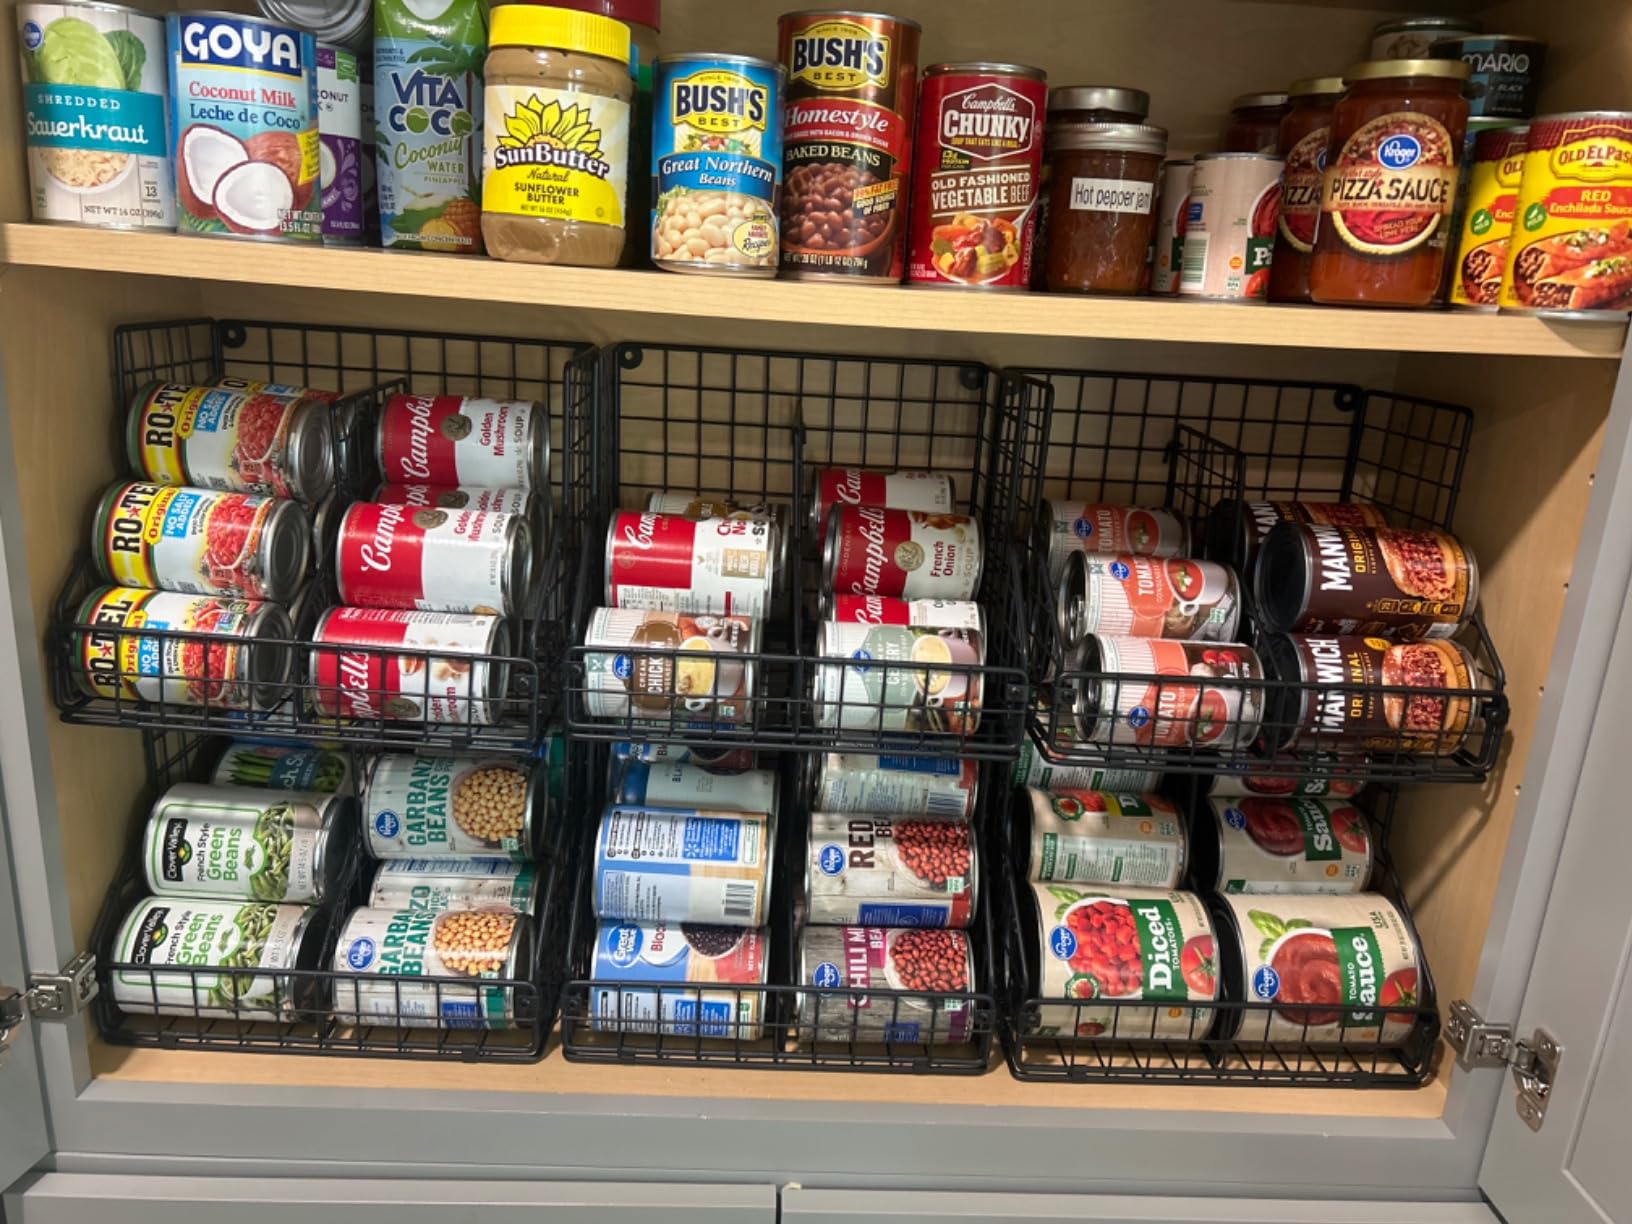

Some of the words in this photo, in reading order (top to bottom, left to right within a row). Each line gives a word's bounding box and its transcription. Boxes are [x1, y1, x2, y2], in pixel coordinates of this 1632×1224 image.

[184, 22, 297, 69] GOYA
[793, 38, 885, 76] BUSH'S
[813, 72, 856, 82] BEST
[1462, 53, 1530, 74] MARIO
[38, 93, 121, 110] SHREDDED
[189, 81, 257, 102] Coconut
[261, 88, 296, 108] Milk
[391, 69, 463, 109] VITA
[676, 84, 764, 122] BUSH'S
[962, 92, 1017, 113] Campbell's
[27, 111, 148, 145] Sauerkraut
[190, 104, 234, 122] Leche
[237, 107, 258, 125] de
[262, 111, 300, 130] Coco
[389, 106, 473, 136] COCO
[698, 116, 740, 127] BEST
[784, 105, 889, 132] Homestyle
[944, 110, 1030, 142] CHUNKY
[394, 137, 464, 169] Coconut
[427, 160, 464, 174] WATER
[495, 143, 609, 179] SunButter
[785, 145, 829, 162] BAKED
[831, 145, 880, 166] BEANS
[1384, 141, 1416, 164] Kroger
[1558, 149, 1586, 165] OLD
[526, 169, 569, 183] Natural
[662, 156, 701, 175] Great
[704, 156, 773, 183] Northern
[700, 174, 737, 187] Beans
[932, 176, 956, 189] OLD
[959, 172, 1030, 188] FASHIONED
[514, 182, 579, 198] SUNFLOWER
[526, 192, 566, 205] BUTTER
[932, 184, 1008, 209] VEGETABLE
[1010, 184, 1030, 204] BEEF
[1074, 183, 1094, 200] Hot
[1096, 189, 1135, 208] pepper
[1330, 178, 1382, 201] PIZZA
[1386, 178, 1450, 204] SAUCE
[1581, 190, 1612, 202] RED
[1550, 204, 1602, 214] Enchilada
[480, 412, 494, 446] Golden
[494, 406, 509, 456] Mushroom
[514, 416, 524, 444] SOUP
[165, 520, 175, 536] NO
[173, 493, 189, 514] SALT
[177, 501, 195, 530] ADDED
[930, 540, 944, 578] French
[944, 544, 956, 576] Onion
[964, 546, 973, 578] SOUP
[142, 654, 152, 674] NO
[648, 640, 665, 694] CHICKN
[887, 642, 899, 685] CEERY
[1348, 652, 1362, 718] ORIINAL
[406, 756, 436, 846] GARBANZ
[428, 774, 450, 843] BEANS
[168, 822, 183, 851] Valley
[196, 822, 212, 848] Style
[378, 813, 398, 836] Kroger
[1304, 802, 1333, 852] Sauc
[206, 826, 226, 881] Green
[223, 828, 242, 882] Beans
[848, 820, 875, 868] RED
[167, 844, 179, 879] Clover
[197, 850, 206, 882] French
[820, 848, 843, 874] Kroger
[174, 909, 192, 932] Style
[176, 912, 208, 966] Green
[192, 914, 224, 967] Beans
[614, 927, 634, 961] Great
[870, 928, 884, 950] BEA
[1138, 906, 1172, 991] Diced
[1164, 920, 1180, 971] TOMATOES
[822, 963, 839, 988] roger
[848, 946, 870, 1008] CHILI
[1260, 968, 1276, 998] Kroger
[1348, 962, 1356, 1001] TOMATO
